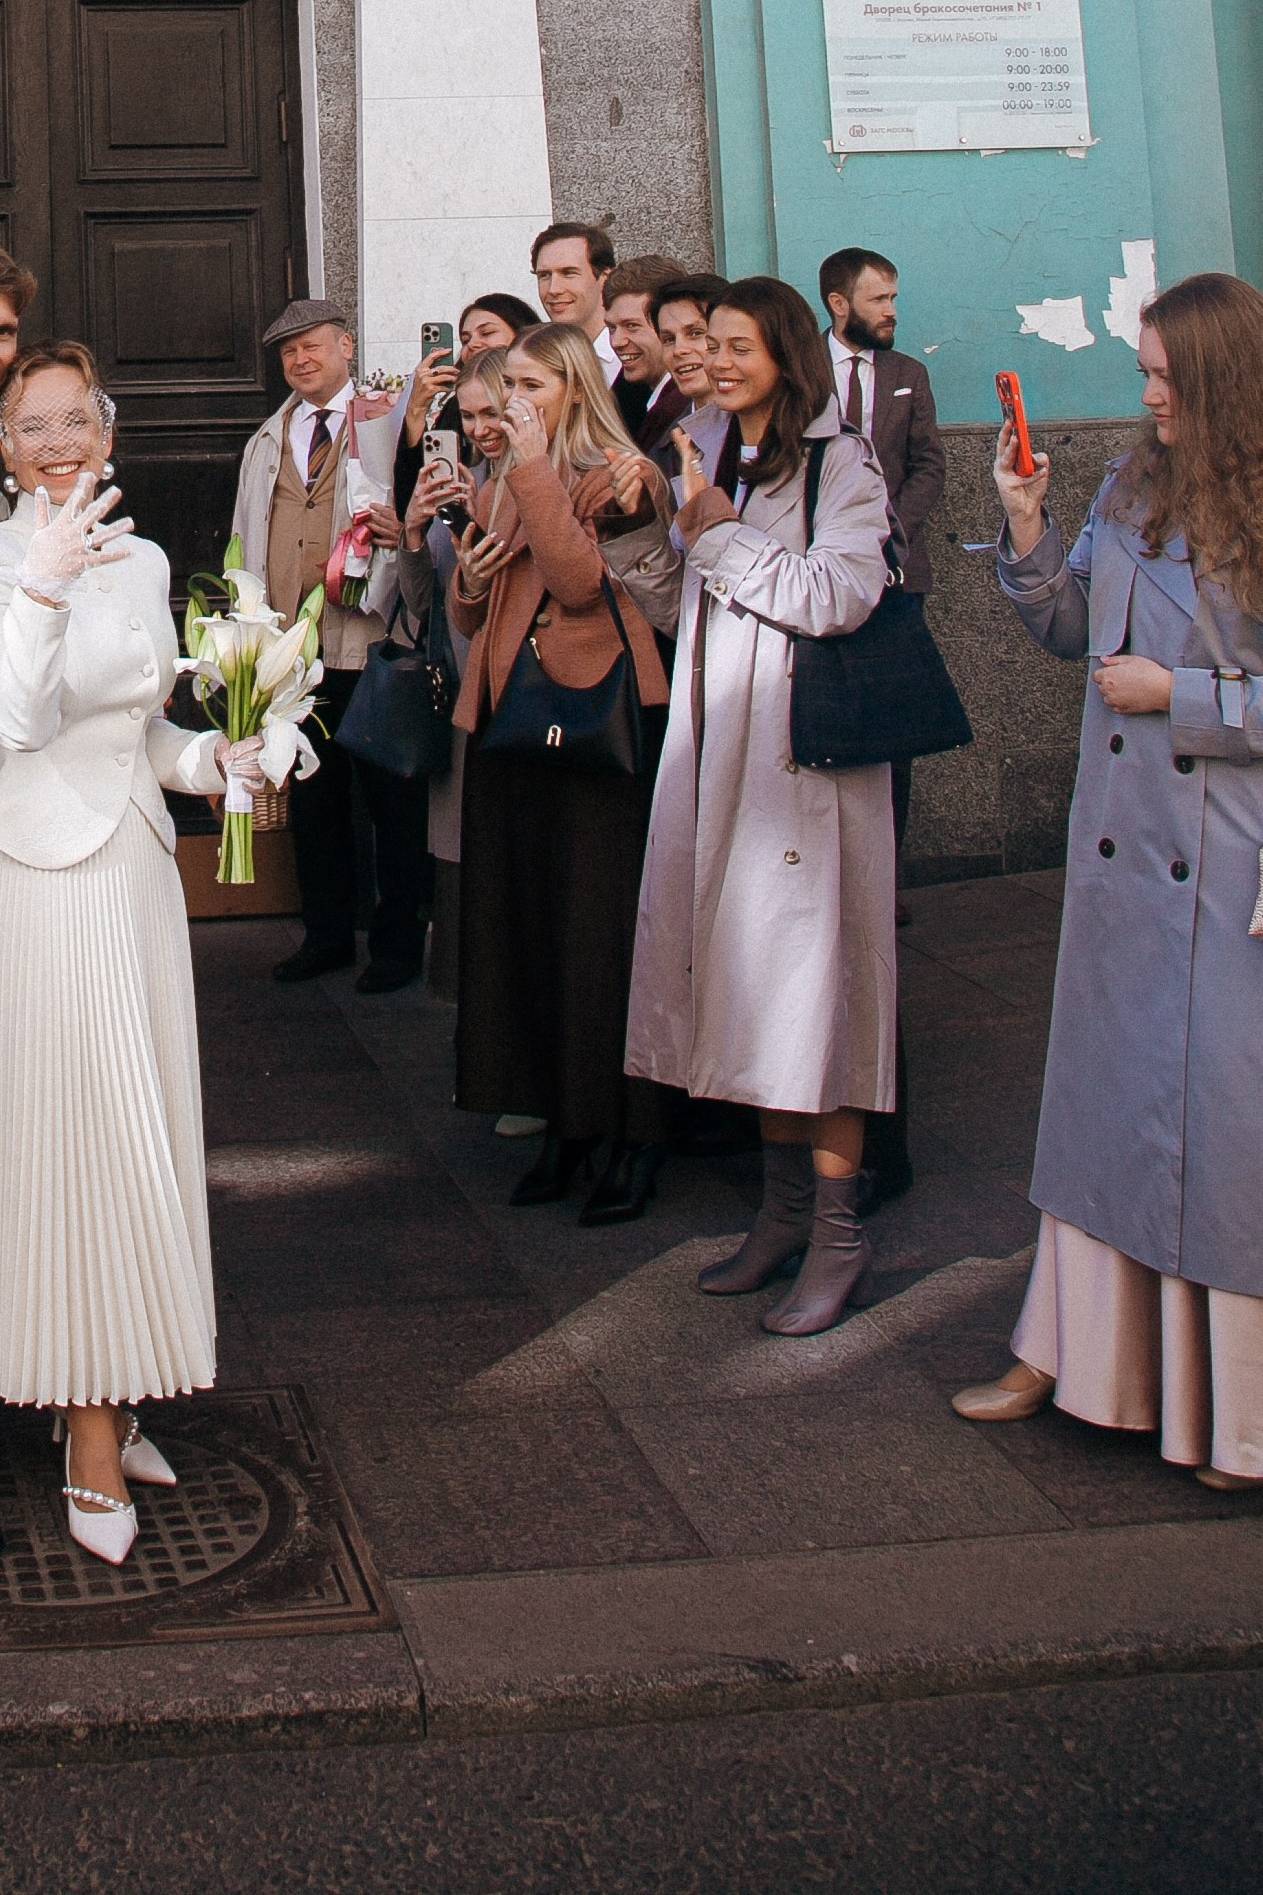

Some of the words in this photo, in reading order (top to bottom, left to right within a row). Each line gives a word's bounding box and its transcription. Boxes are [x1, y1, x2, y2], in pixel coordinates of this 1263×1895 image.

[863, 3, 910, 16] Дворец
[913, 2, 1014, 15] бракосочетания
[1036, 1, 1042, 11] 1
[912, 33, 953, 43] РЕЖИМ
[956, 32, 998, 42] РАБОТЫ
[1005, 47, 1029, 58] 9:00
[1040, 47, 1068, 57] 18:00
[1007, 64, 1031, 75] 9:00
[1039, 64, 1069, 74] 20:00
[1008, 82, 1032, 92] 9:00
[1041, 81, 1070, 92] 23:59
[1002, 99, 1033, 110] 00:00
[1044, 98, 1072, 109] 19:00
